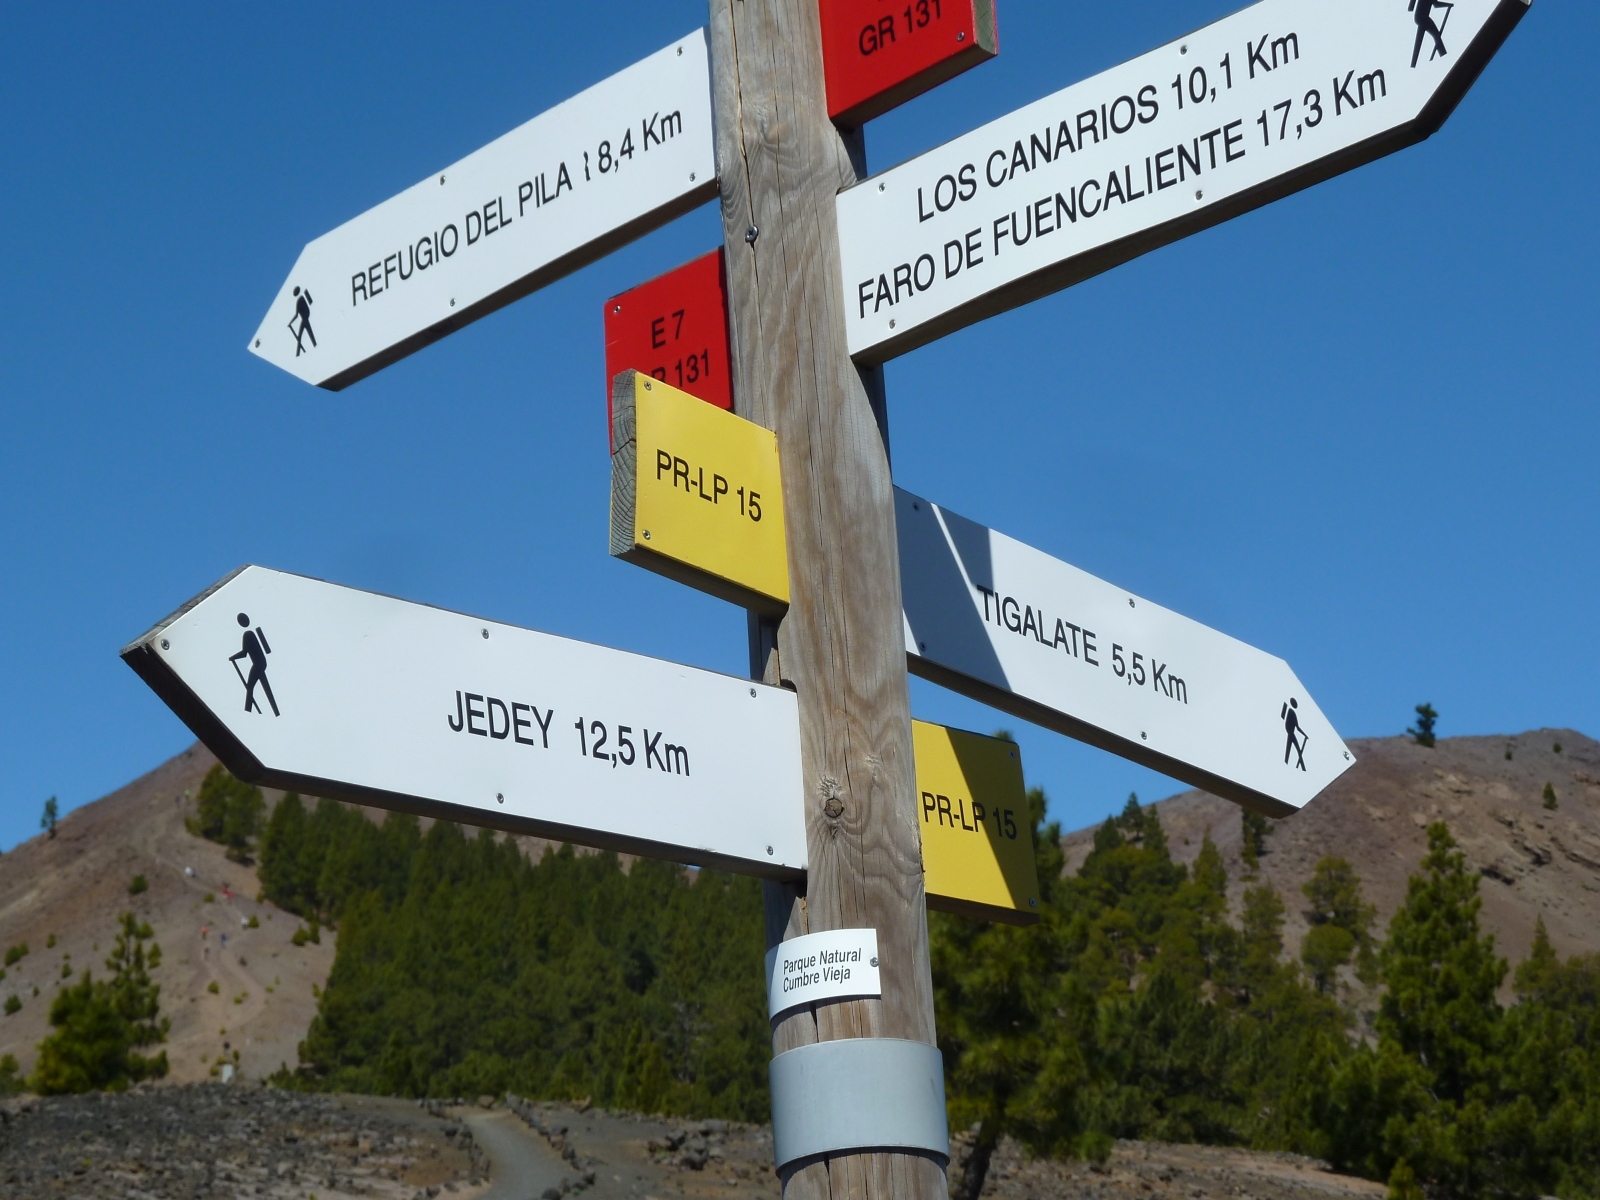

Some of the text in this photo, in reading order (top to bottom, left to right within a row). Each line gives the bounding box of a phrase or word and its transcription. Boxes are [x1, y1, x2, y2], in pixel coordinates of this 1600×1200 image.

[858, 0, 941, 56] GR 131
[917, 32, 1300, 224] LOS CANARIOS 10,1 Km
[351, 223, 459, 307] REFUGIO
[465, 196, 513, 246] DEL
[642, 109, 682, 152] Km
[858, 68, 1387, 320] FARO DE FUENCALIENTE 17,3 Km
[651, 309, 685, 349] E 7
[674, 348, 709, 387] 131
[656, 448, 762, 523] PR-LP 15
[976, 584, 1189, 705] TIGALATE 5,5 Km
[447, 690, 690, 777] JEDEY 12,5 Km
[921, 791, 1018, 840] PR-LP 15
[783, 948, 862, 976] Parque Natural
[783, 966, 851, 993] Cumbre Vieja
